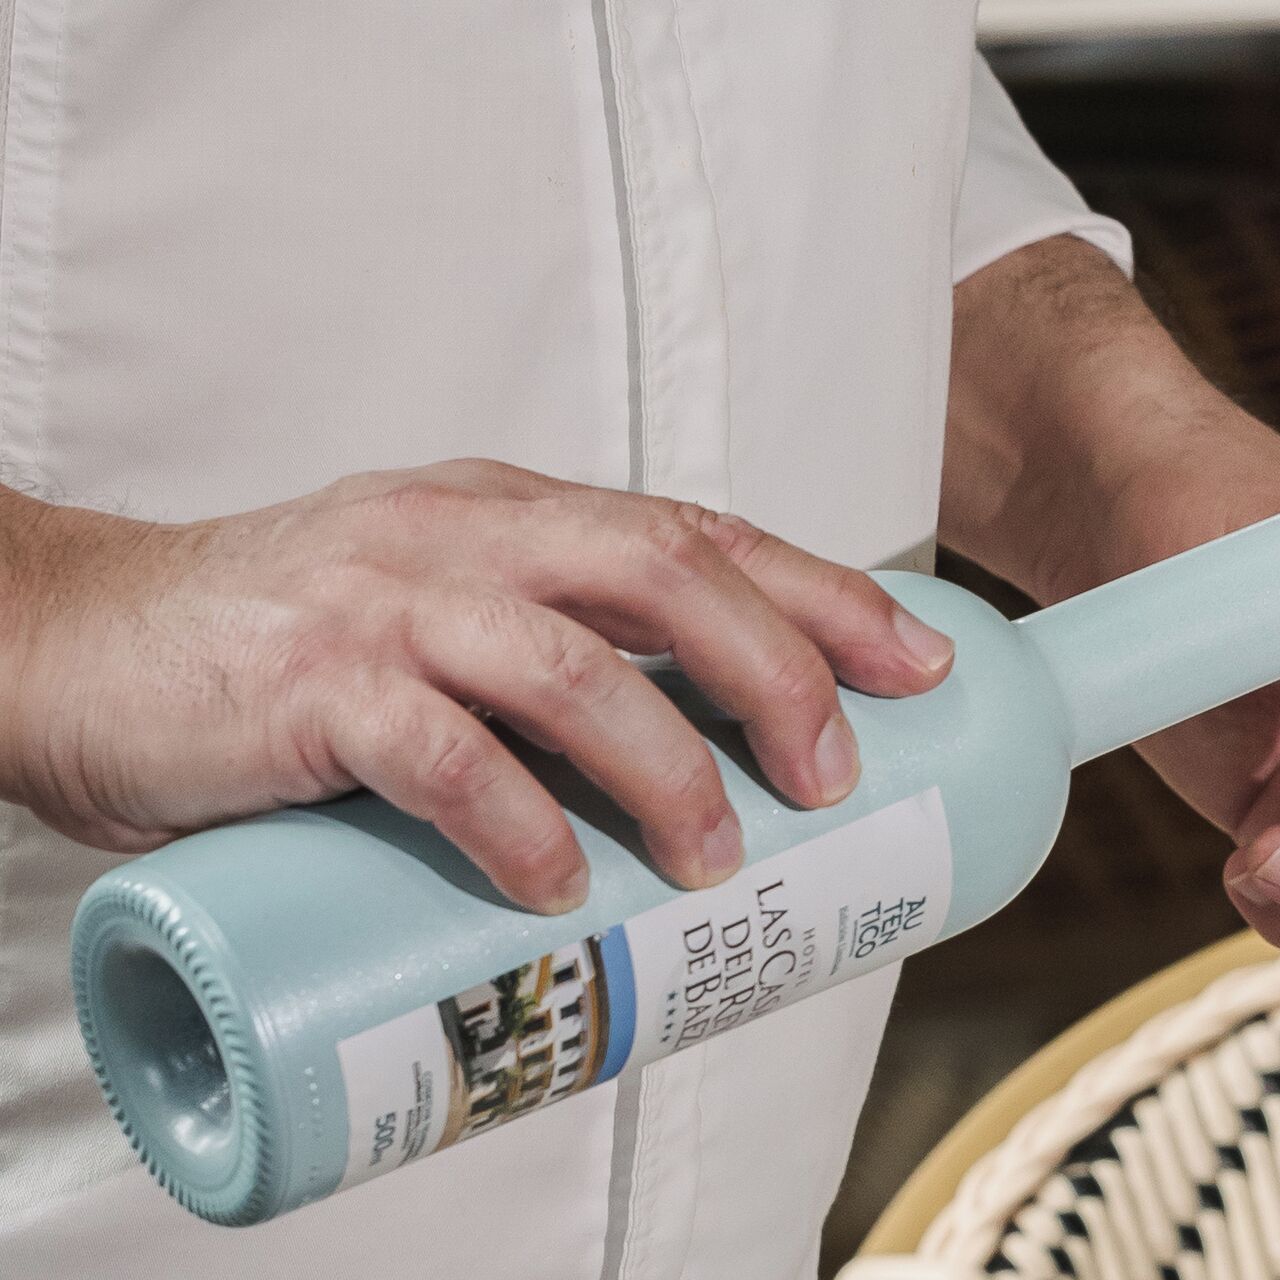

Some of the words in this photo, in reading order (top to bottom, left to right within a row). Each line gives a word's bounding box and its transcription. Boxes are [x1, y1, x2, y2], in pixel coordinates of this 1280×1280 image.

[855, 901, 882, 959] TICO
[879, 897, 904, 946] TEN
[903, 895, 926, 932] AU
